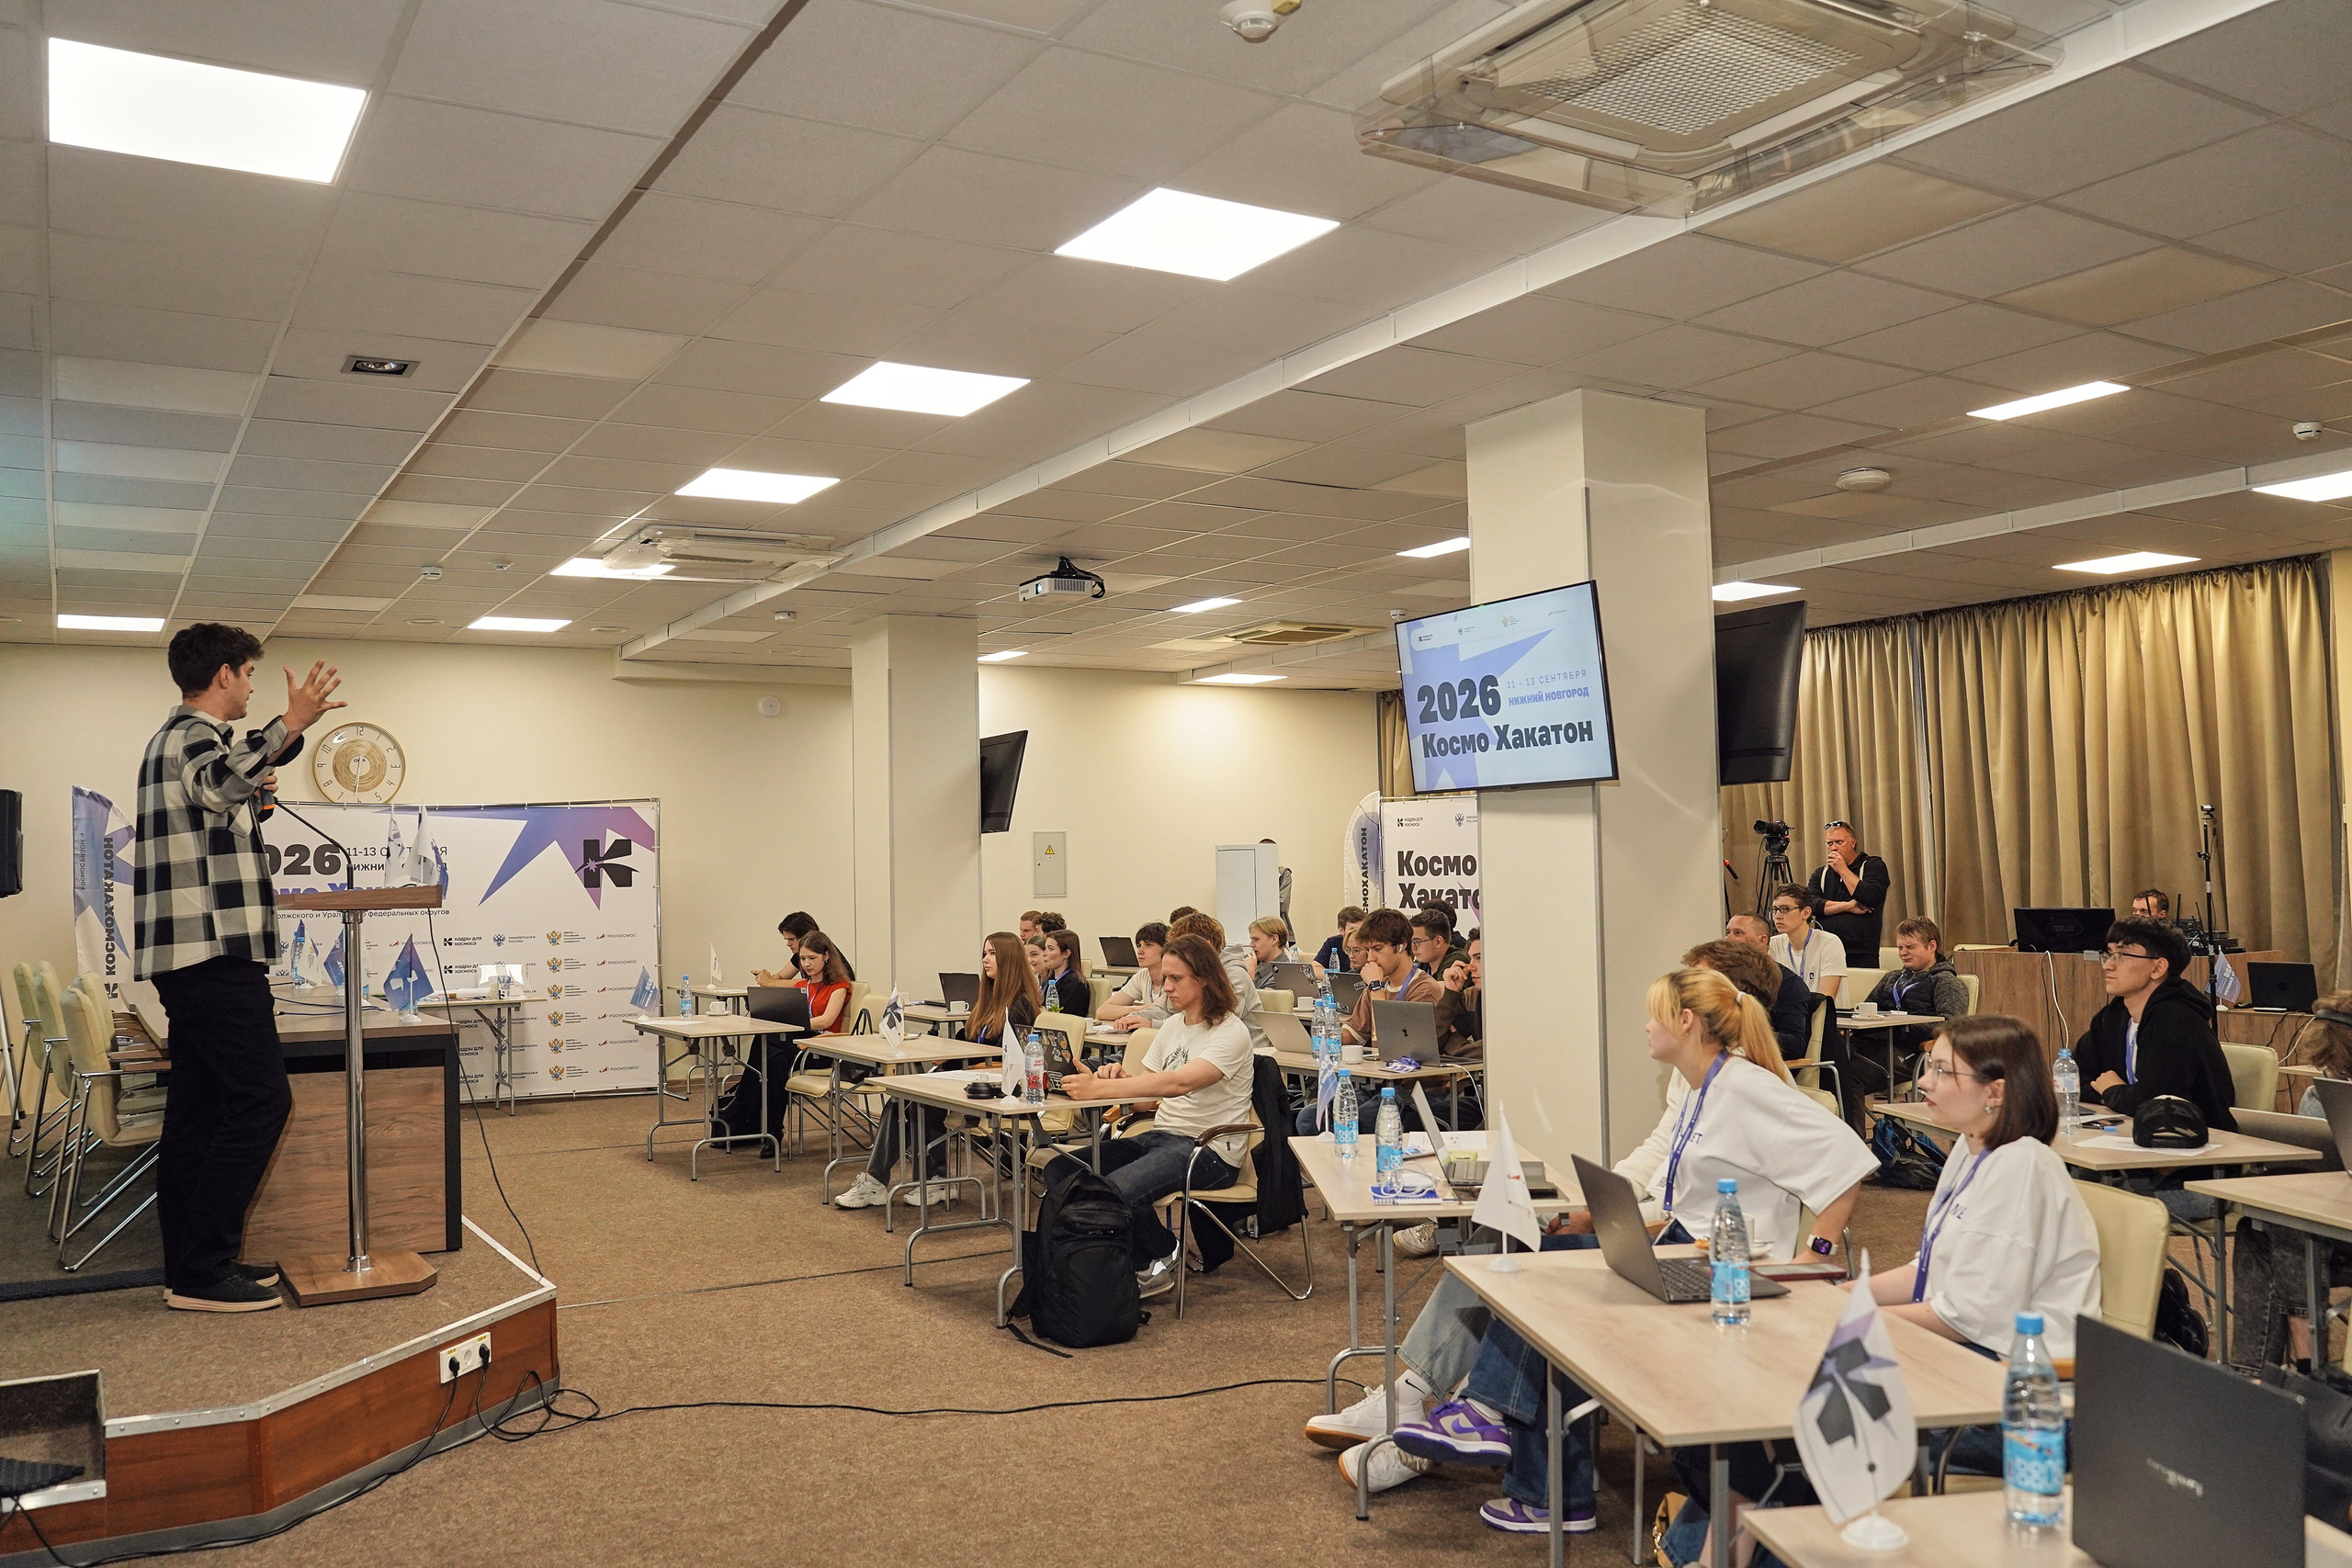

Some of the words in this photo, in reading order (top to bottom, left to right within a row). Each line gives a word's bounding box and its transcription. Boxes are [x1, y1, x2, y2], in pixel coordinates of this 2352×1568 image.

[1507, 681, 1515, 689] 11
[1525, 677, 1535, 686] 13
[1539, 669, 1587, 684] СЕНТЯБРЯ
[1418, 674, 1501, 724] 2026
[1508, 691, 1544, 706] НИЖНИЙ
[1544, 686, 1589, 702] НОВГОРОД
[356, 726, 364, 736] 12
[1421, 732, 1490, 759] Космо
[1493, 720, 1594, 751] Хакатон
[321, 744, 333, 754] 10
[264, 843, 342, 875] 026
[346, 847, 377, 857] 11-13
[1361, 827, 1369, 915] СМОХАКАТОН
[1397, 851, 1477, 877] Космо
[277, 911, 313, 919] олжского
[368, 909, 419, 918] федеральных
[420, 908, 450, 917] округов
